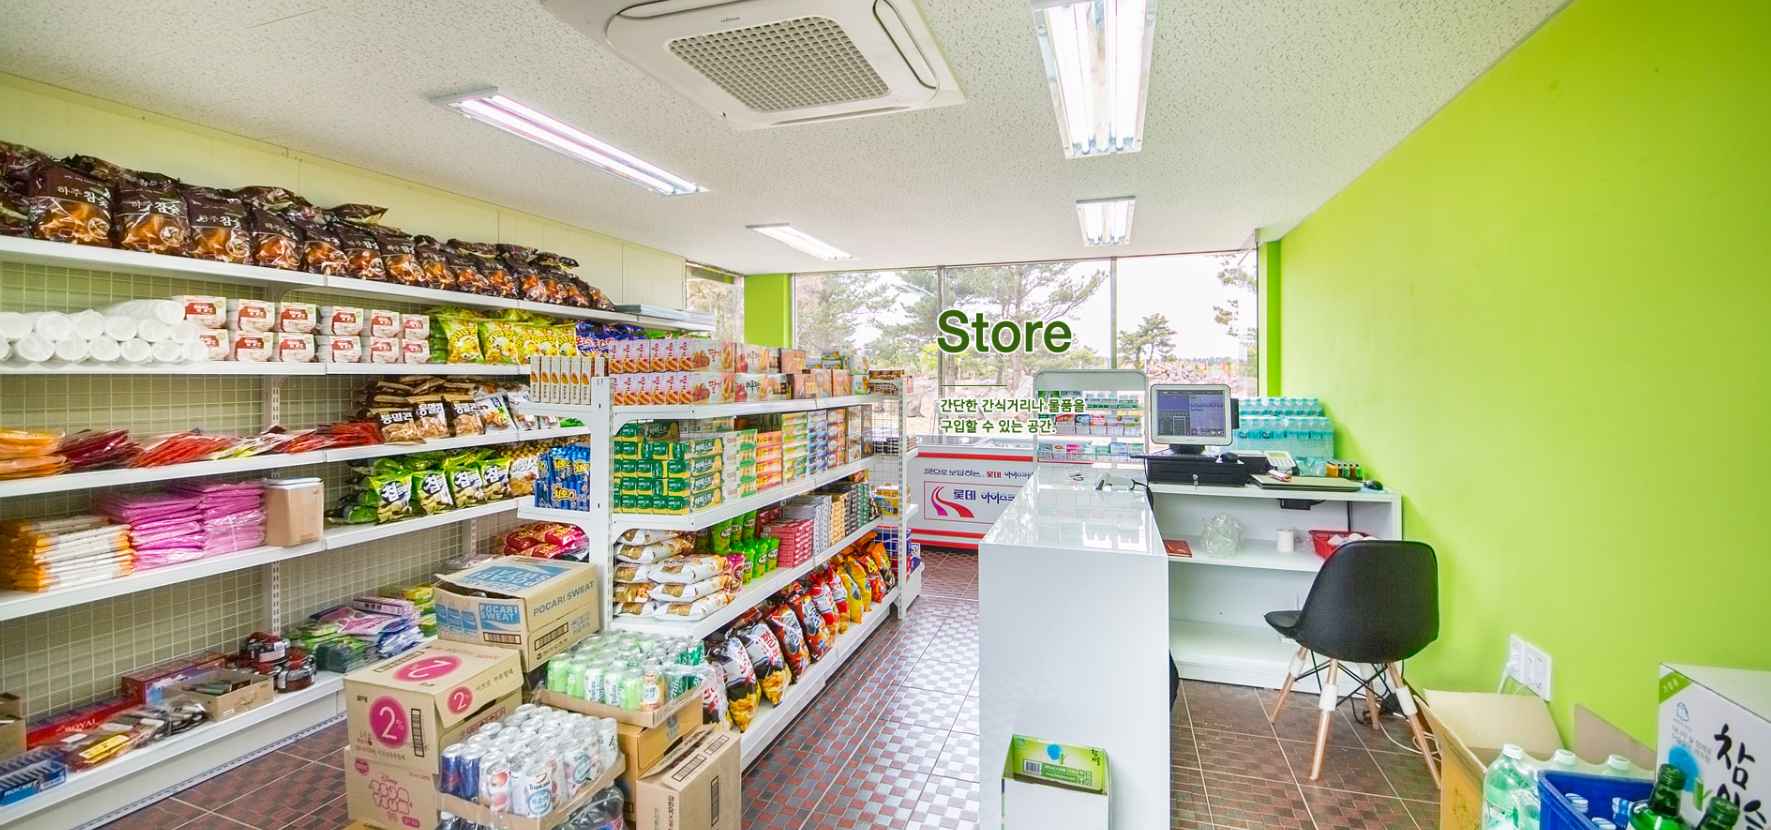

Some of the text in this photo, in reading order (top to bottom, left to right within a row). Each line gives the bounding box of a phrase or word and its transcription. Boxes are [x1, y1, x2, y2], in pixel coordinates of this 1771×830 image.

[953, 488, 976, 501] 롯데
[470, 571, 537, 588] POCARI
[533, 580, 594, 617] POCARI SWEAT
[479, 604, 518, 615] POCARI
[480, 611, 515, 621] SWEAT
[64, 718, 99, 733] ROYAL
